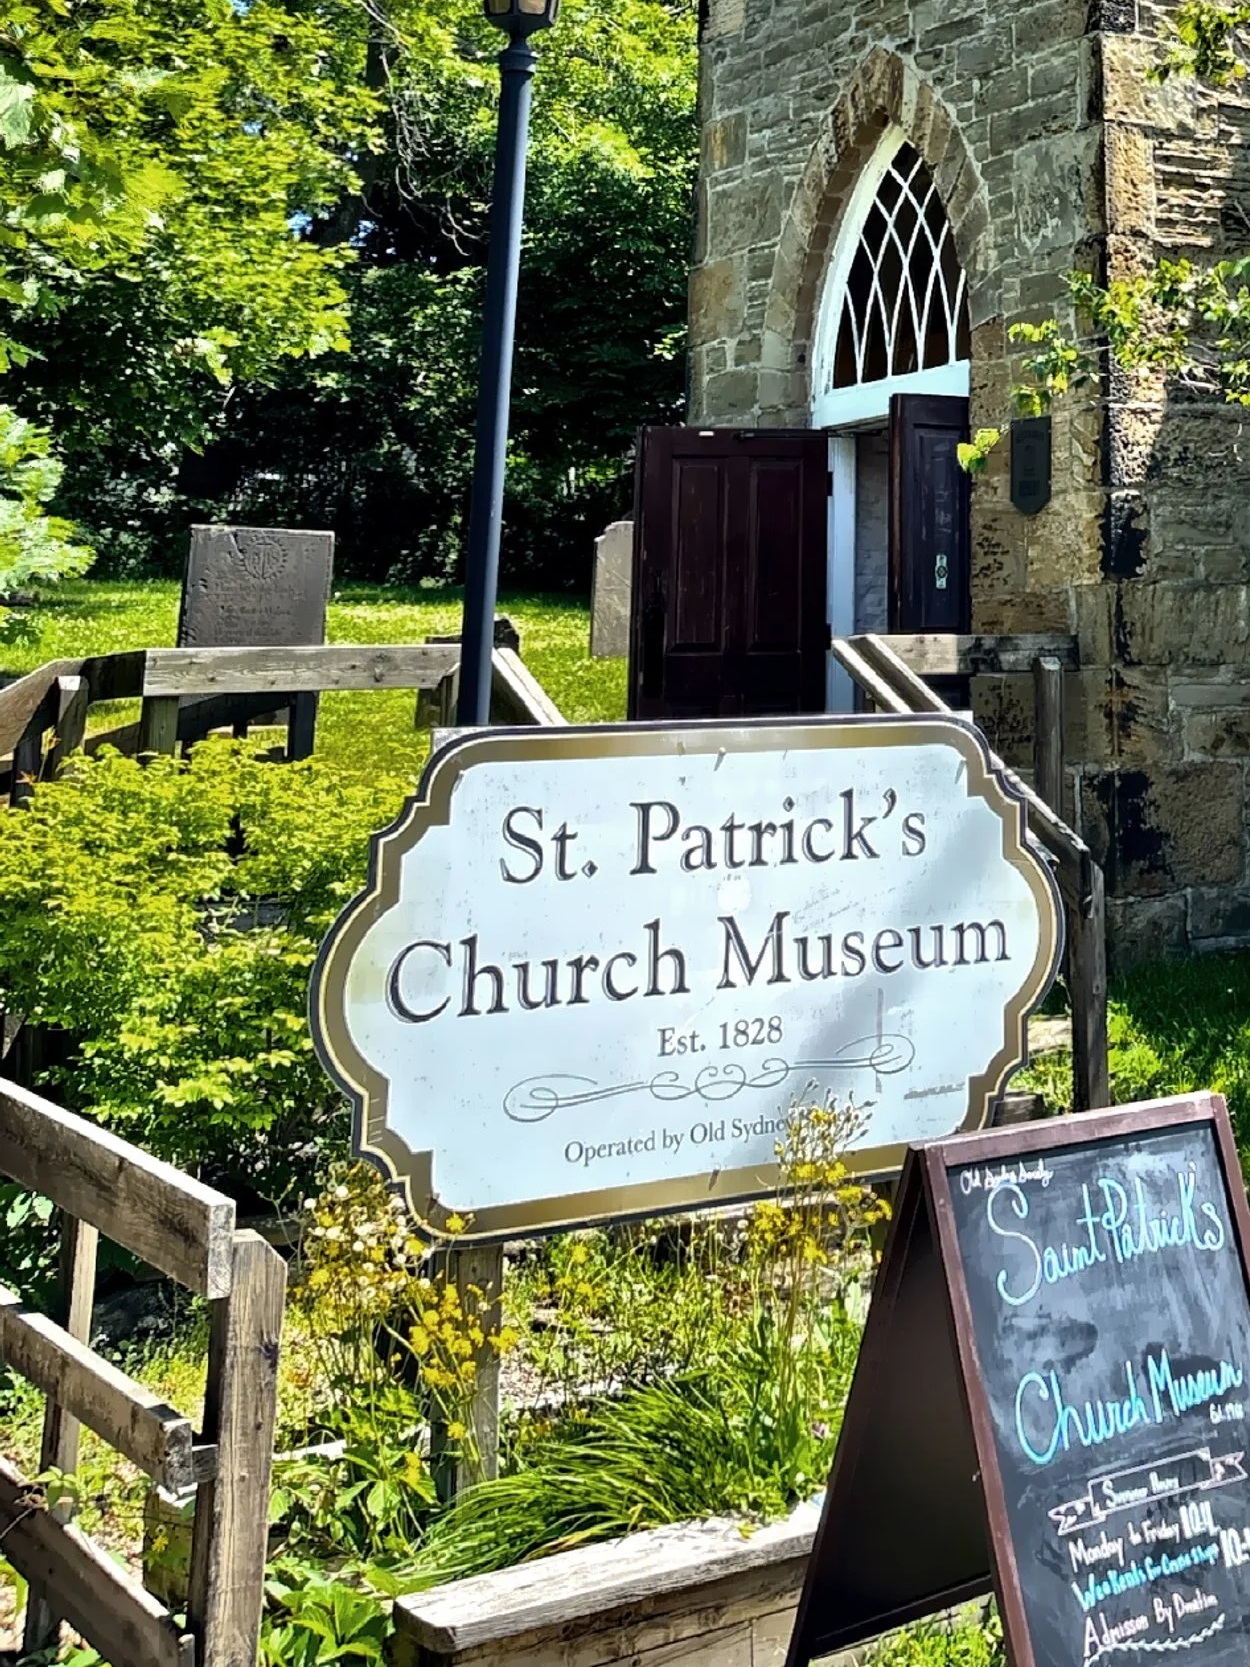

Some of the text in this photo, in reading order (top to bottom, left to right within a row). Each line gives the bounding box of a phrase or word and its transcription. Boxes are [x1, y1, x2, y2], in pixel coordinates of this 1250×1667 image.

[498, 786, 927, 885] St. Patrick's
[385, 910, 1012, 1024] Church Museum
[657, 1016, 784, 1057] Est. 1828
[564, 1127, 657, 1168] Operated
[661, 1123, 684, 1152] by
[690, 1119, 726, 1145] Old
[986, 1181, 1107, 1307] Saint
[1015, 1359, 1150, 1466] Church
[1067, 1530, 1125, 1573] Monday
[1140, 1517, 1180, 1545] Friday
[1152, 1596, 1175, 1634] By
